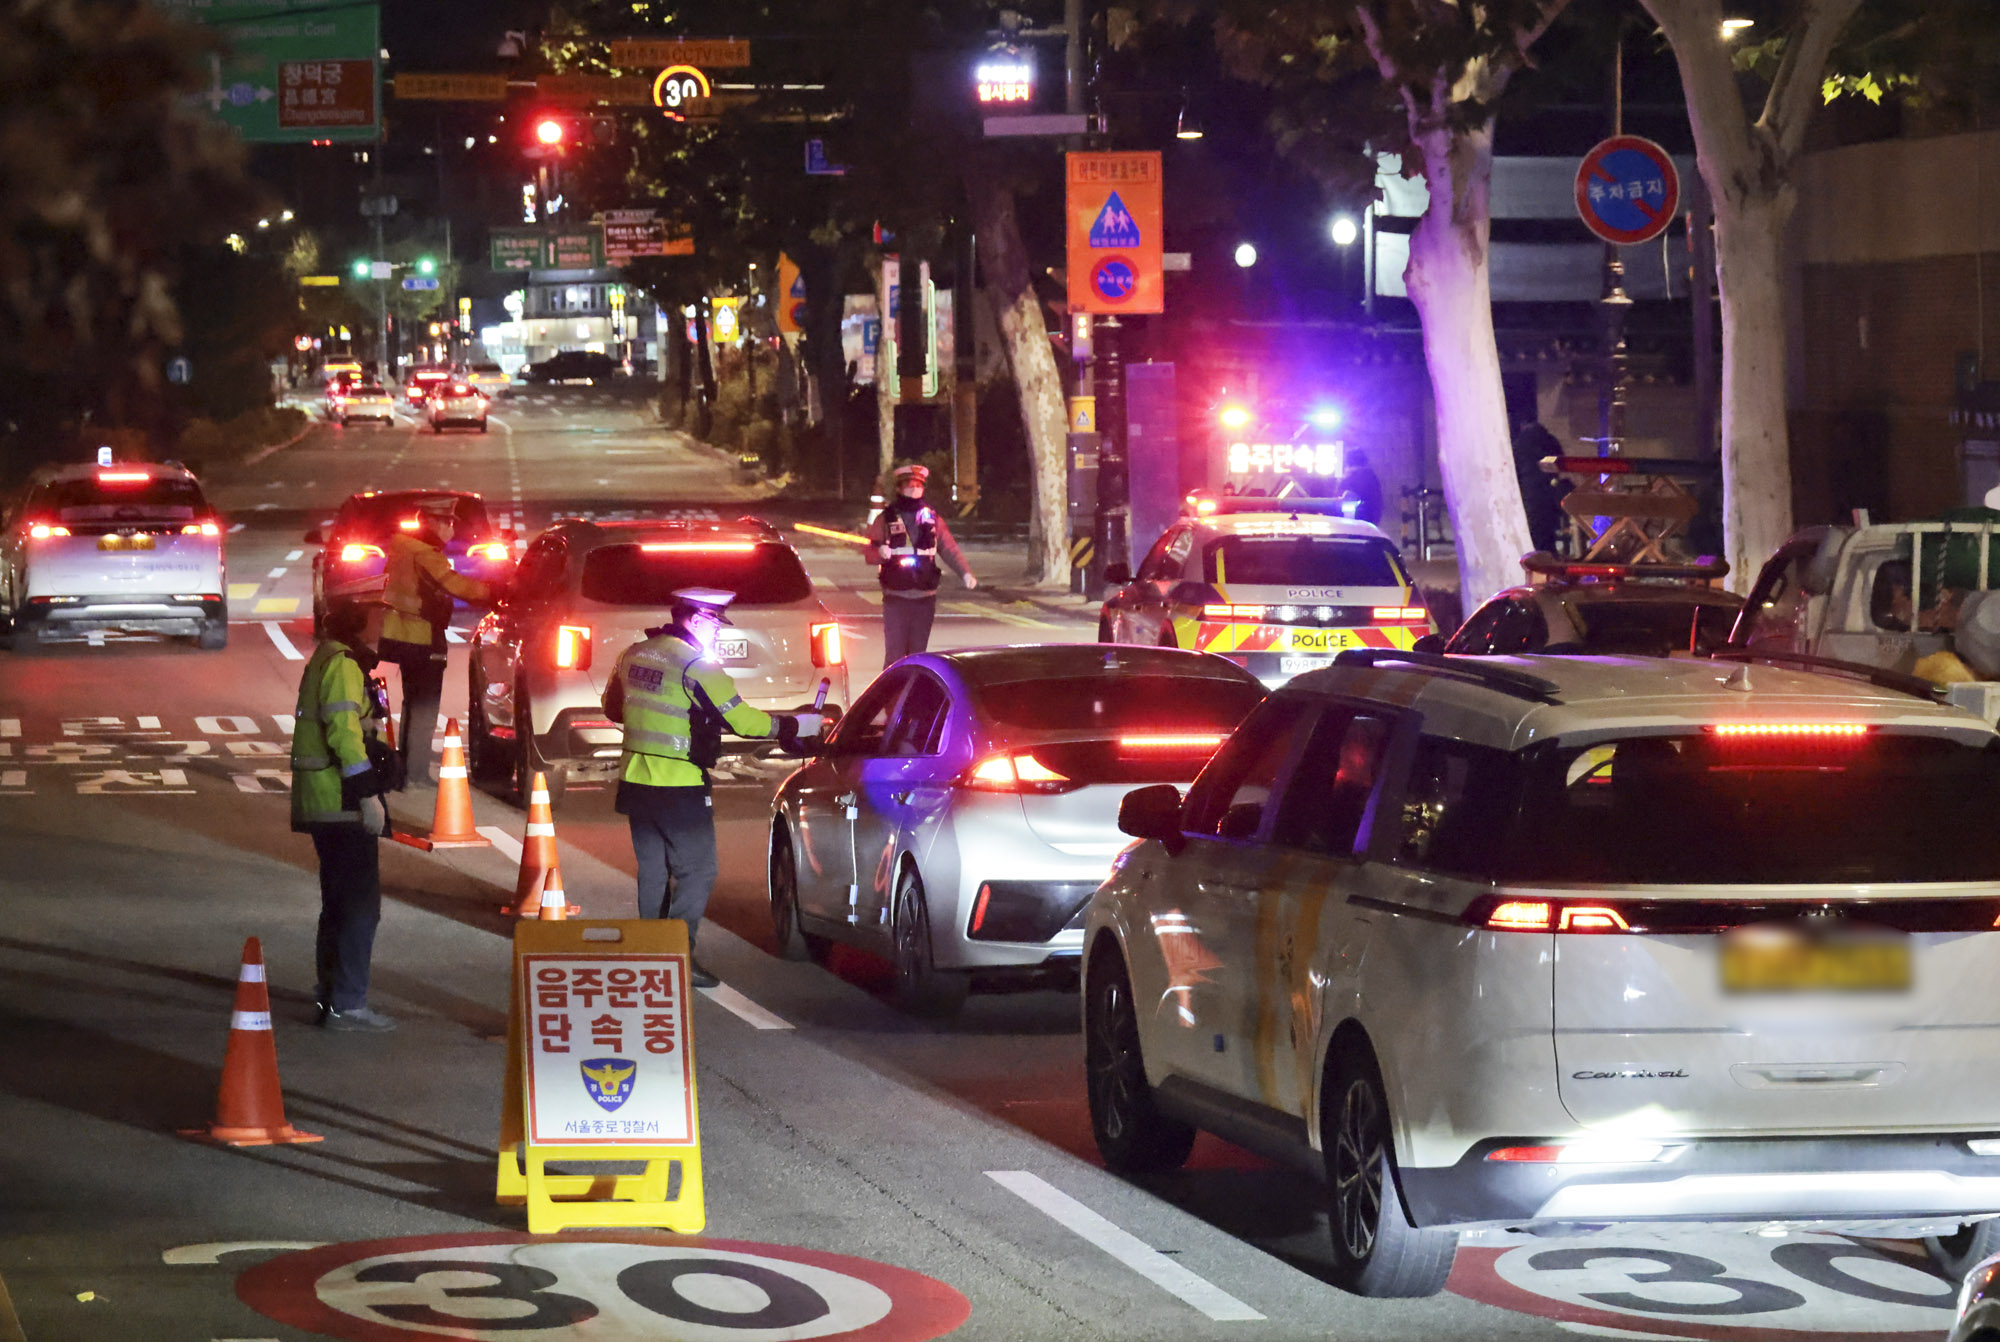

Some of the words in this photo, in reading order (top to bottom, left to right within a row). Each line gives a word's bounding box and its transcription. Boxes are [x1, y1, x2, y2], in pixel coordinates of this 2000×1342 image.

[284, 63, 343, 85] 창덕궁
[1079, 160, 1148, 181] 어린이보호구역
[1589, 178, 1663, 204] 주차금지
[1228, 443, 1338, 475] 음주단속중
[1288, 588, 1345, 599] POLICE
[1291, 634, 1348, 648] POLICE
[536, 967, 674, 1009] 음주운전
[597, 1095, 623, 1104] POLICE
[564, 1119, 660, 1135] 서울종로경찰서
[1527, 1242, 1960, 1316] 30
[354, 1256, 832, 1333] 30
